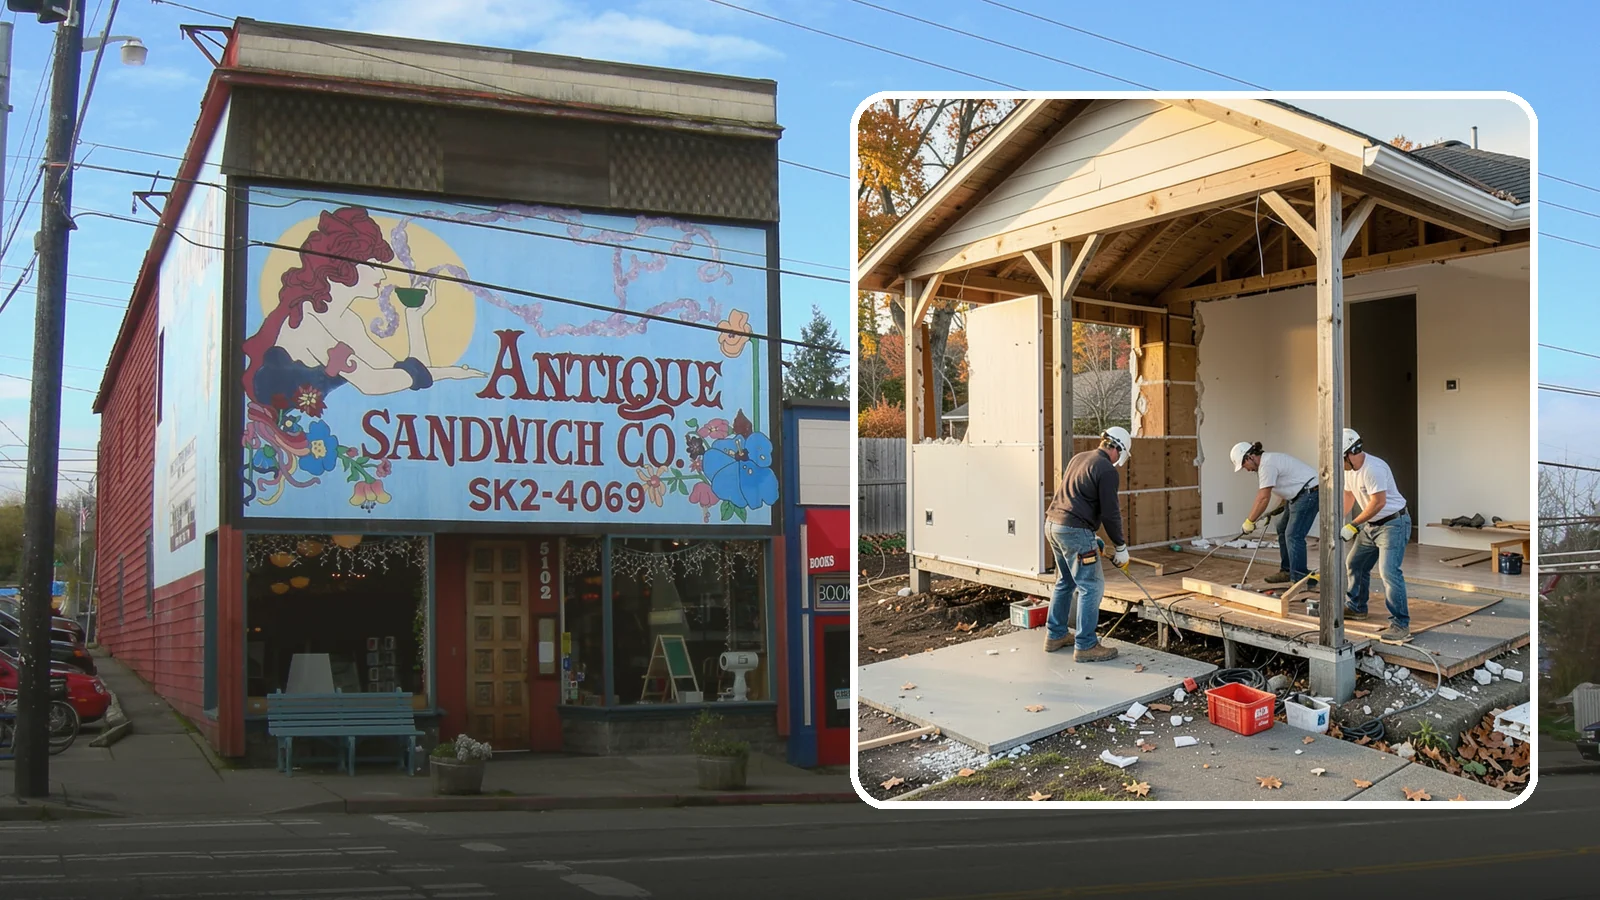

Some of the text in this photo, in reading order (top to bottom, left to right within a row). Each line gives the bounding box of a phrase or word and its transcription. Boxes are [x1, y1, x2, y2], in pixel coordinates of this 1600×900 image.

[475, 329, 724, 421] ANTIQUE
[361, 408, 686, 470] SANDWICH CO.
[468, 477, 646, 514] SK2-4069
[540, 541, 552, 599] 5102
[809, 555, 835, 569] BOOKS
